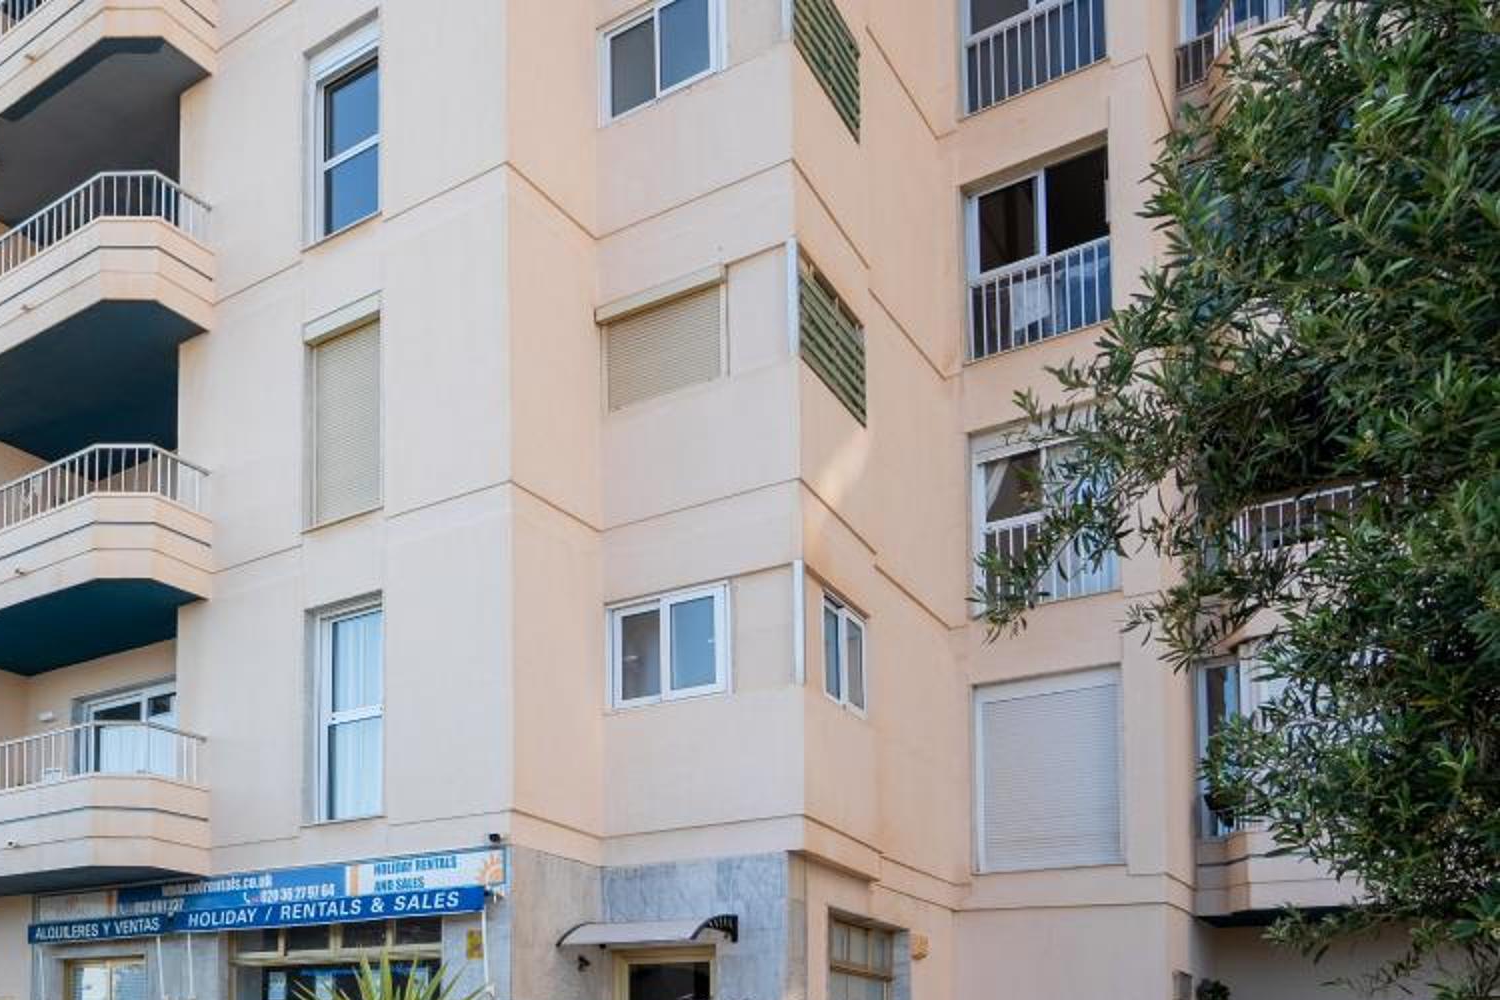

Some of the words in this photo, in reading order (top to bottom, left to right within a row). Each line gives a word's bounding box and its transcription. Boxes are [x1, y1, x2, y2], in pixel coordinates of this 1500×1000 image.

[374, 859, 412, 876] HOLIDAY
[415, 855, 457, 872] RENTALS
[373, 878, 393, 893] AND
[393, 876, 425, 890] SALES
[188, 908, 257, 928] HOLIDAY
[265, 906, 273, 921] /
[280, 899, 361, 920] RENTALS
[370, 897, 384, 913] &
[393, 891, 460, 911] SALES
[35, 922, 99, 941] ALQUILERES
[100, 921, 110, 936] Y
[115, 916, 161, 935] VENTAS
